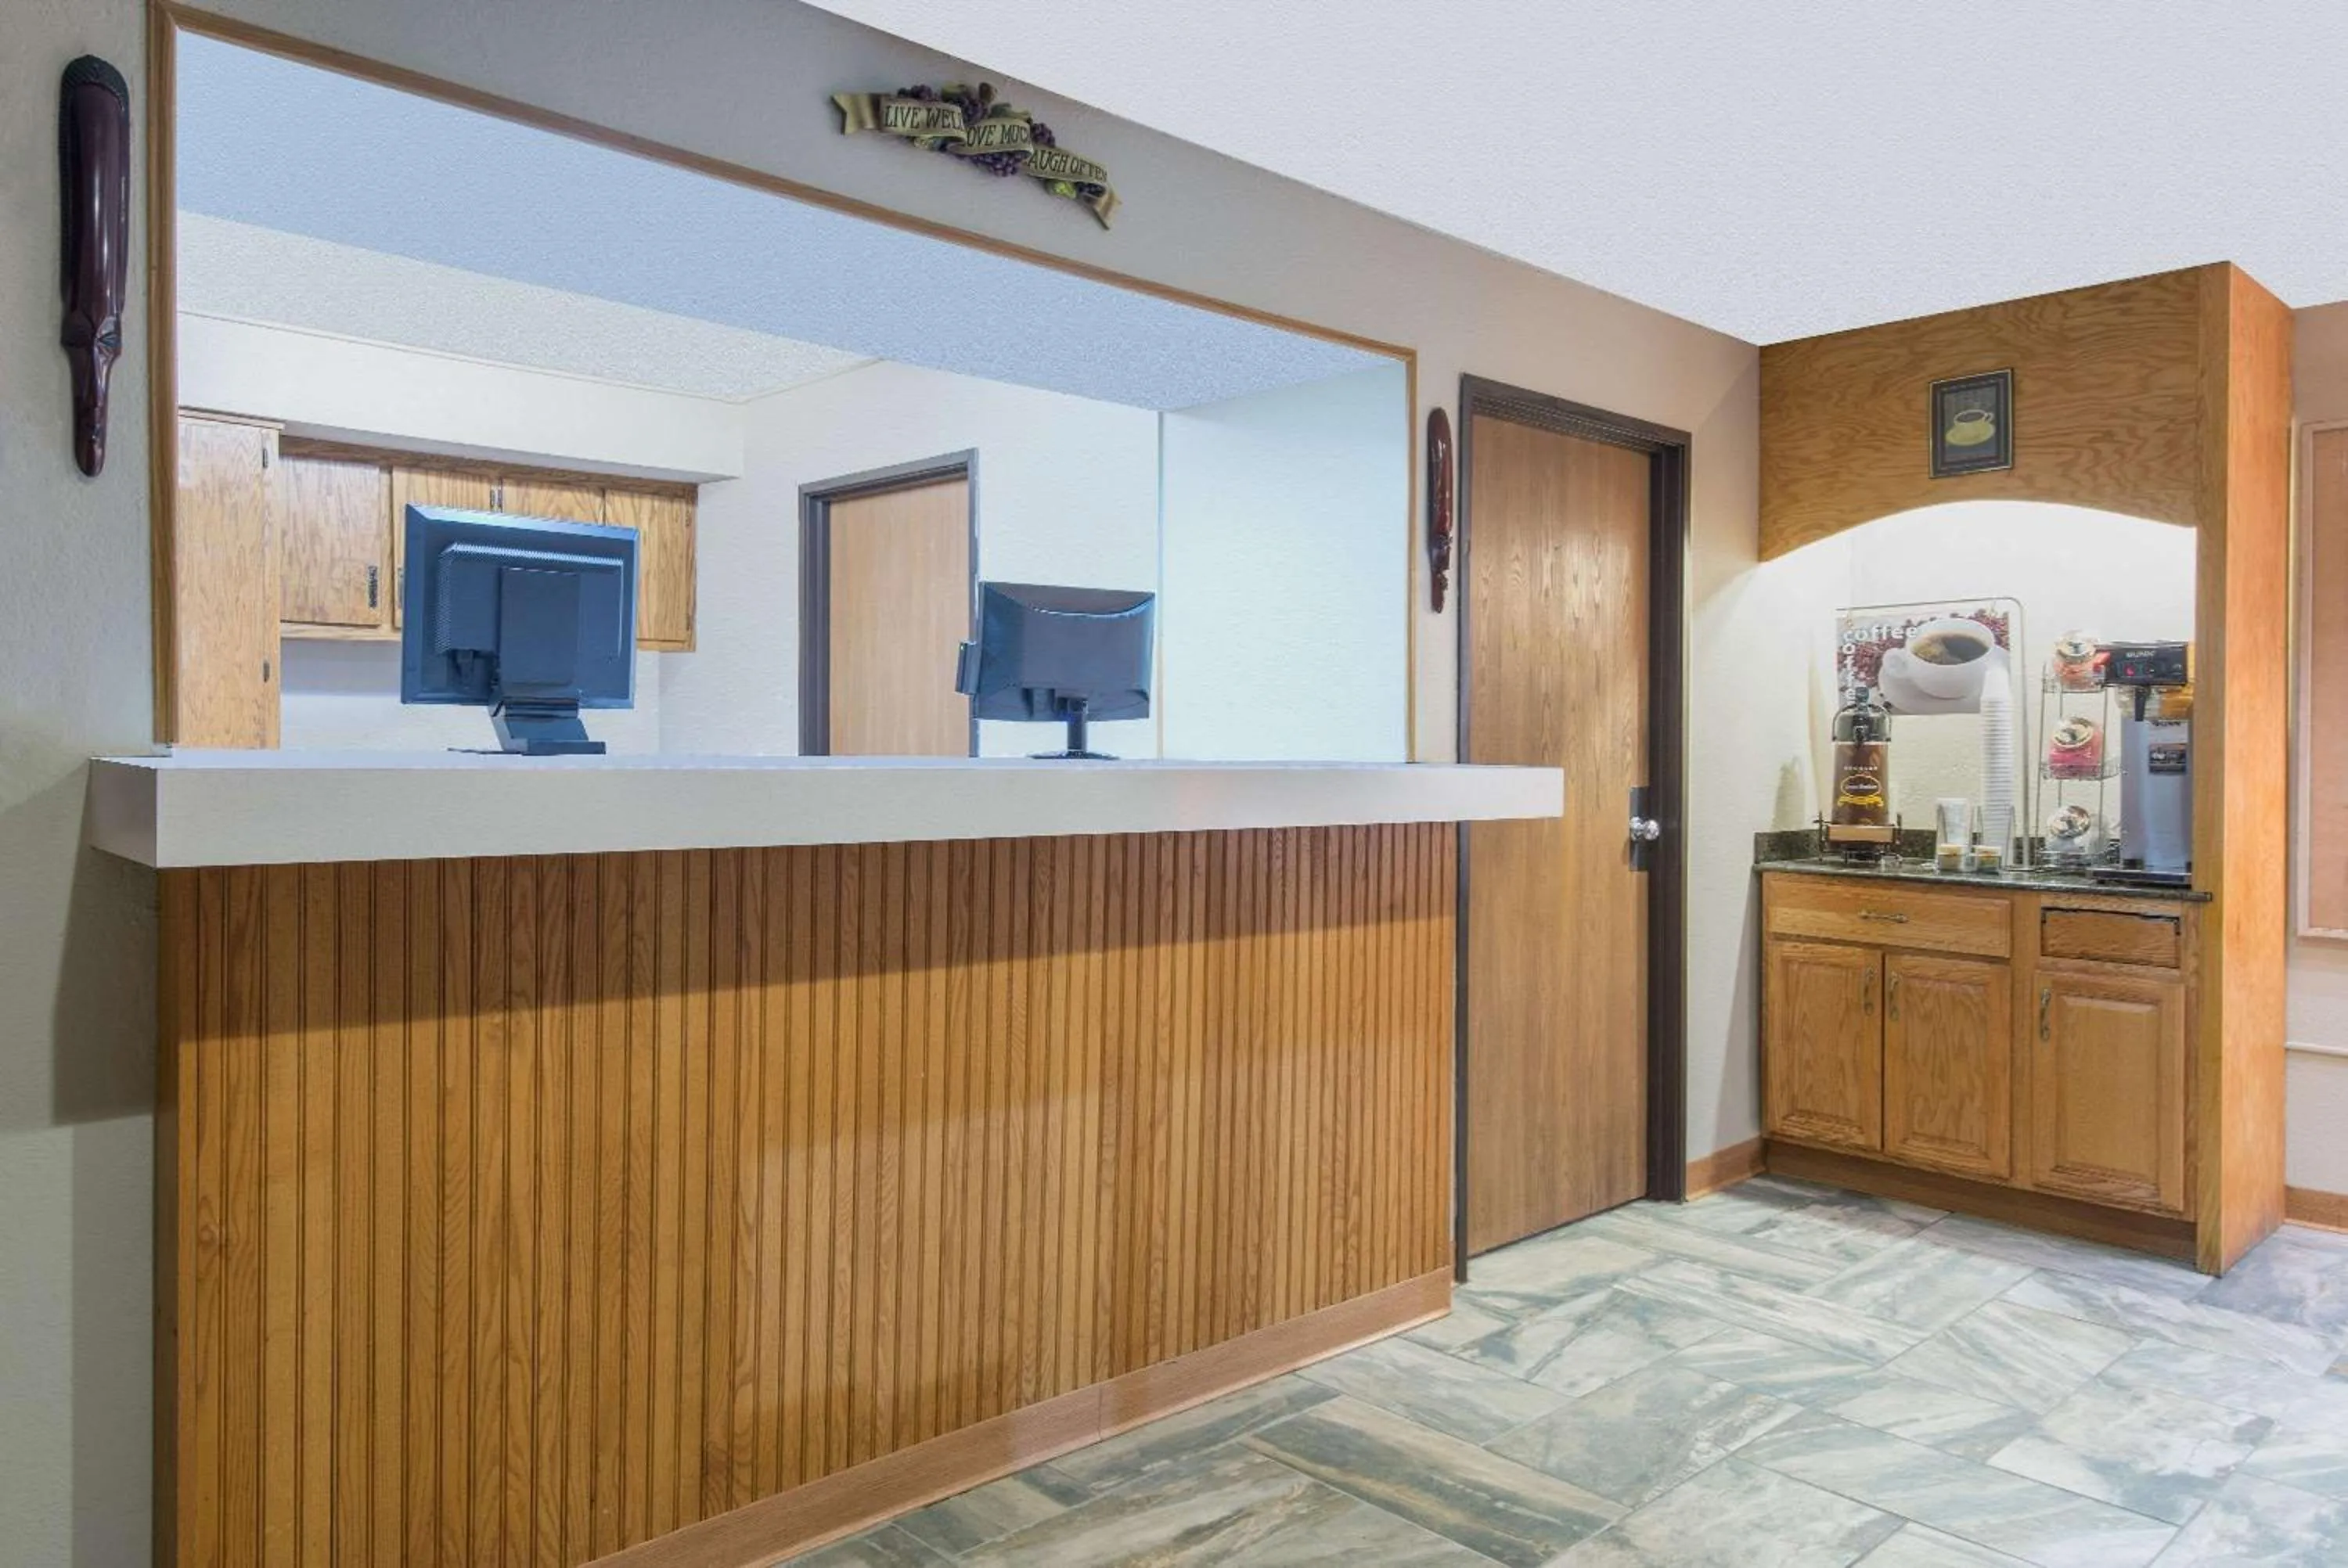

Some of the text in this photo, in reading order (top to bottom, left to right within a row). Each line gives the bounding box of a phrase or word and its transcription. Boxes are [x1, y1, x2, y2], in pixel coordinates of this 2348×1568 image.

[884, 104, 921, 128] LIVE
[965, 124, 1030, 147] OVE MUC
[1027, 149, 1069, 173] AUGH
[1842, 624, 1917, 642] coffee
[1842, 630, 1856, 706] coffe
